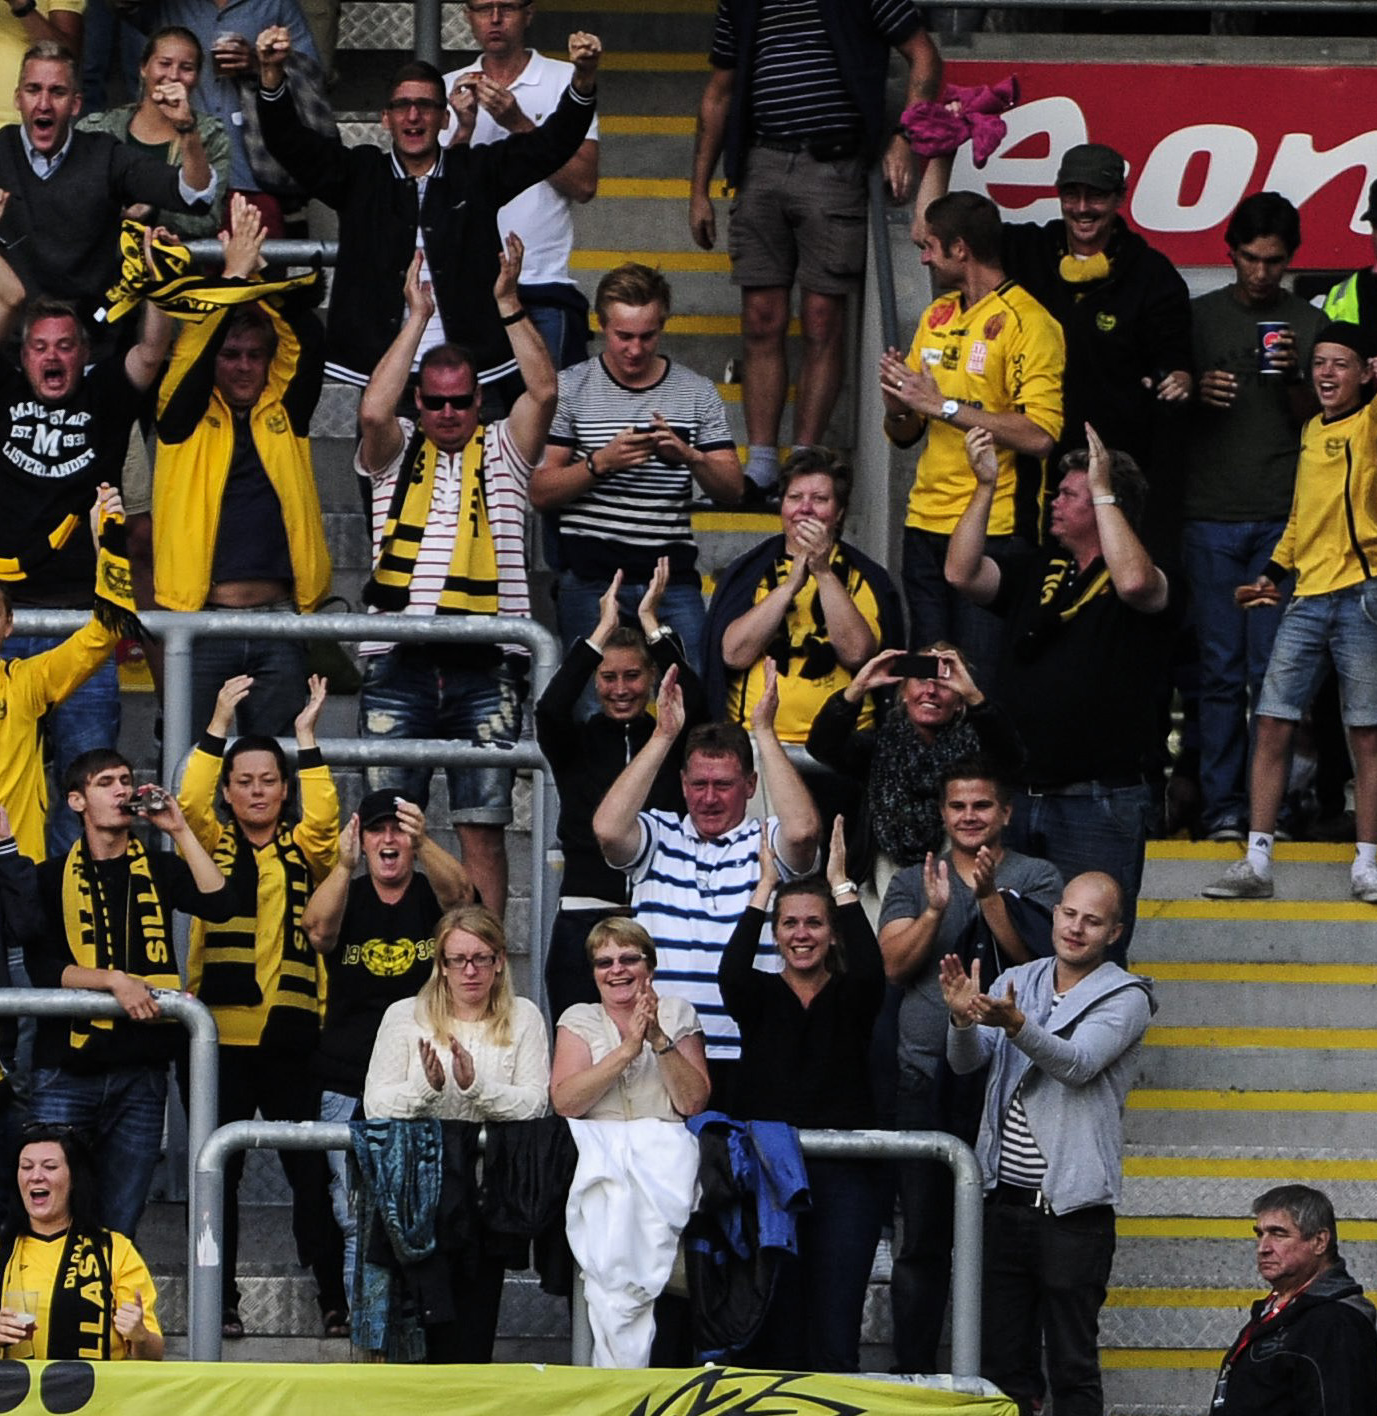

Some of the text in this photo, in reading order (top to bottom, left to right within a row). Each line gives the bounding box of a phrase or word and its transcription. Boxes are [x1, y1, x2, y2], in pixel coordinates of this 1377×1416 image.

[11, 425, 33, 439] EST.
[32, 423, 63, 457] M
[2, 441, 96, 478] LISTERLANDET
